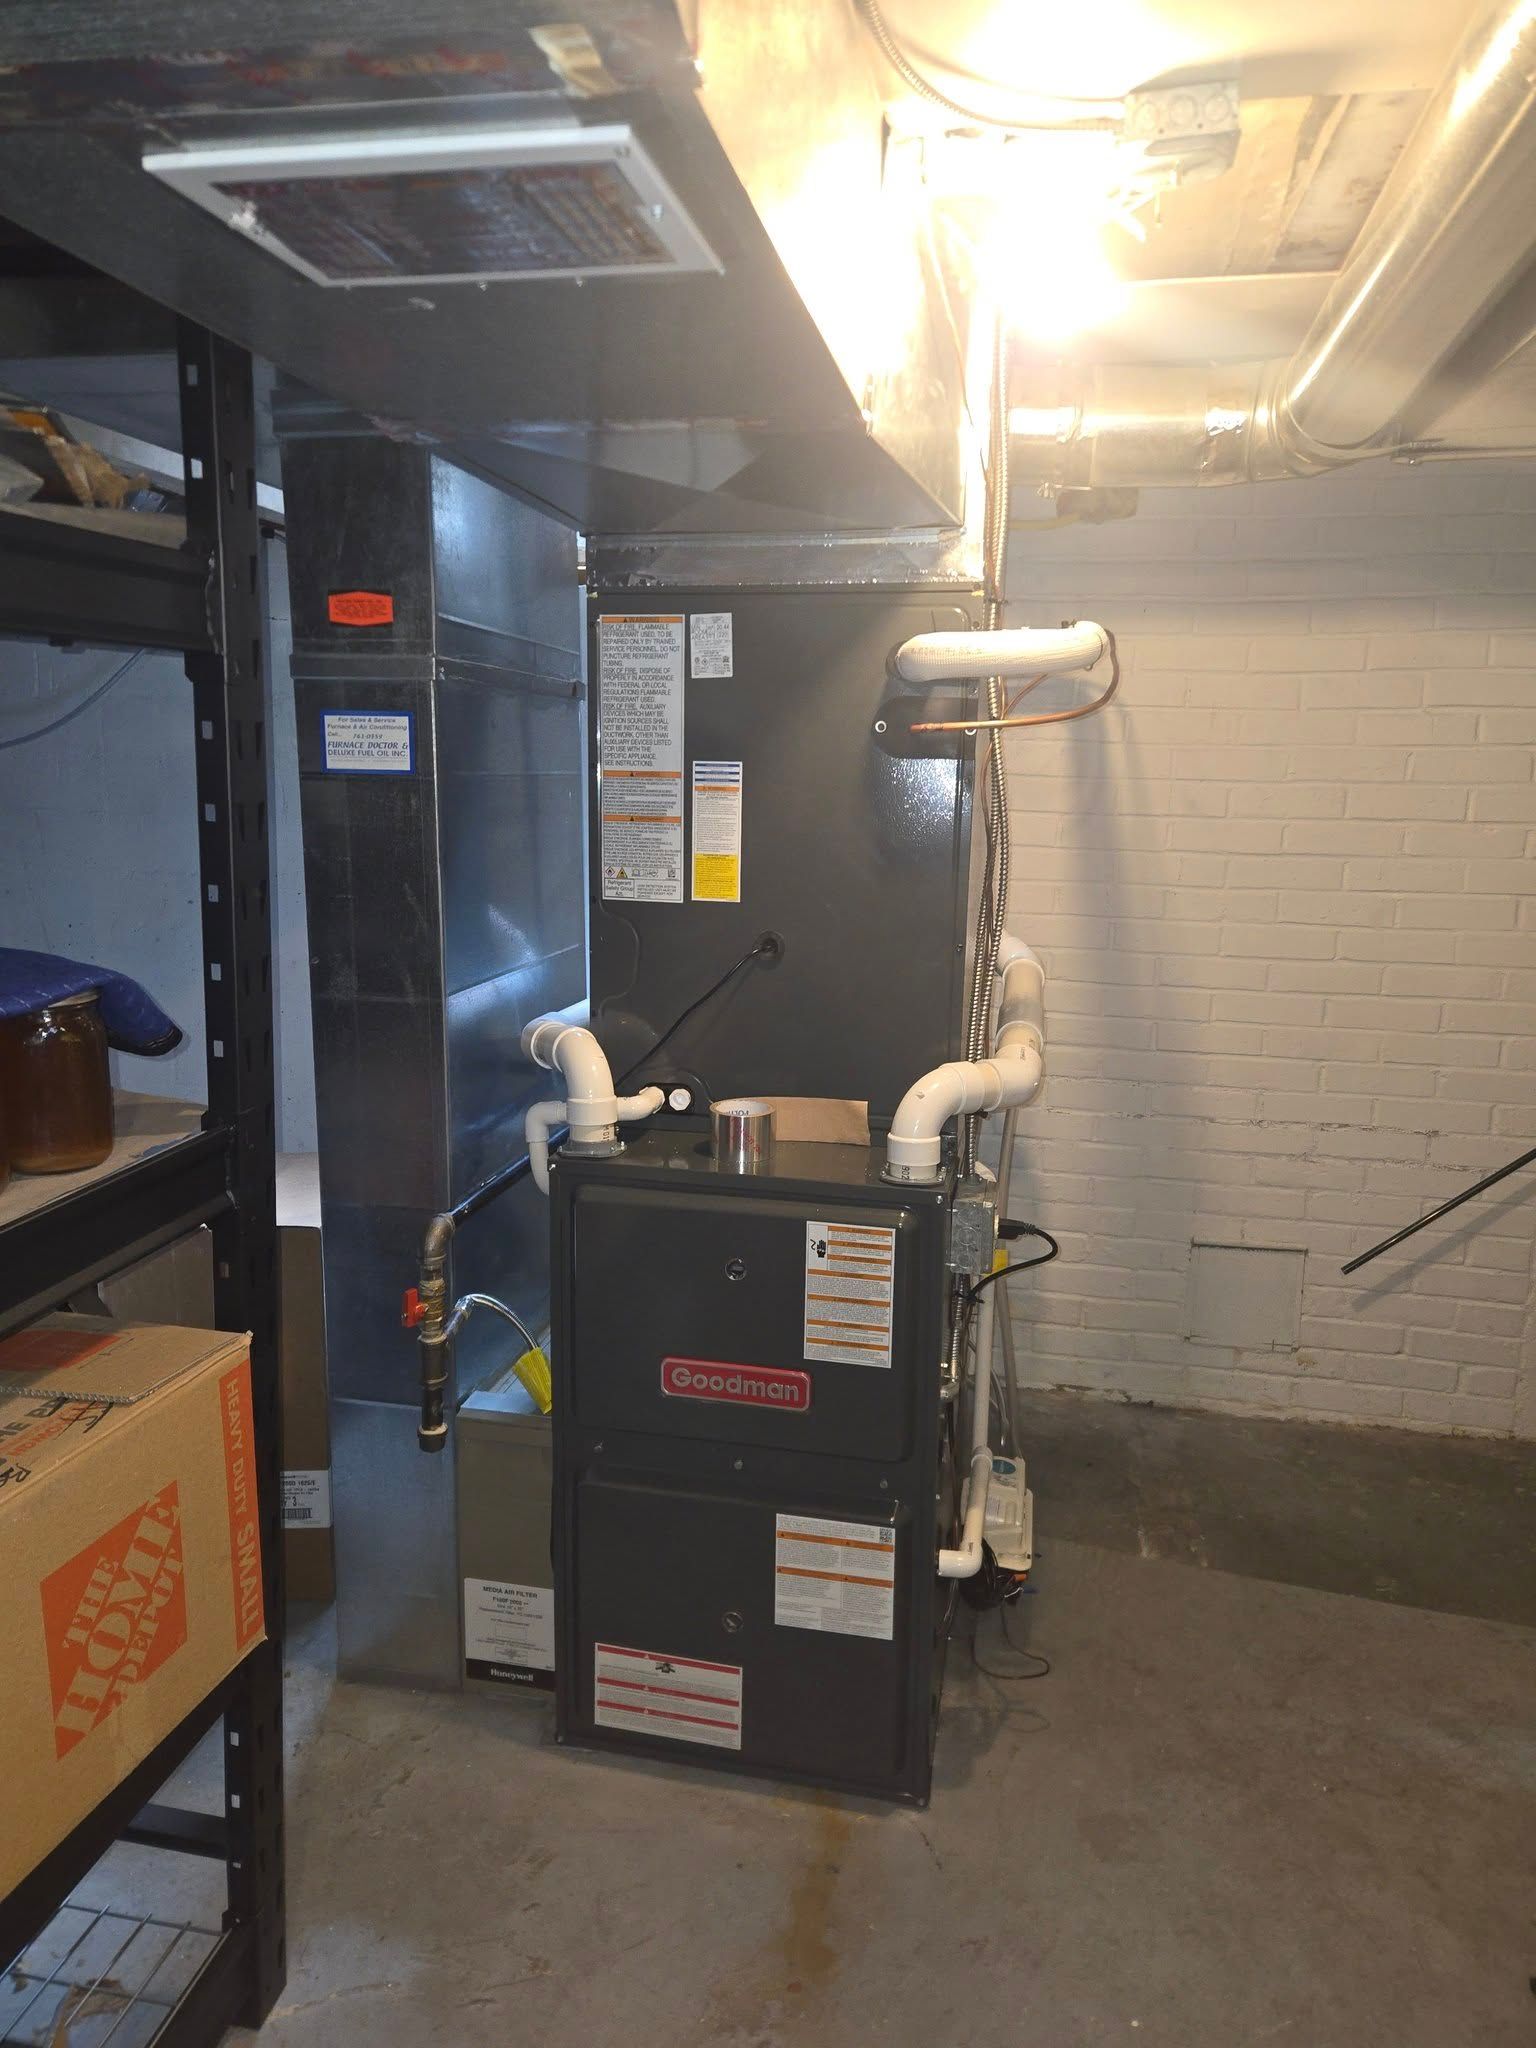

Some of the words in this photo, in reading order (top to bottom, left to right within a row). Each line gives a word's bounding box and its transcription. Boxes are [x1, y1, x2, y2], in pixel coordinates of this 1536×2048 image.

[226, 1378, 243, 1452] HEAVY
[671, 1367, 800, 1402] Goodman
[232, 1457, 248, 1514] DUTY
[55, 1494, 180, 1732] HOME
[63, 1553, 119, 1648] THE
[237, 1522, 258, 1635] SMALL
[516, 1591, 538, 1599] FILTER
[111, 1548, 184, 1715] DEPOT
[490, 1668, 534, 1682] Honeywell
